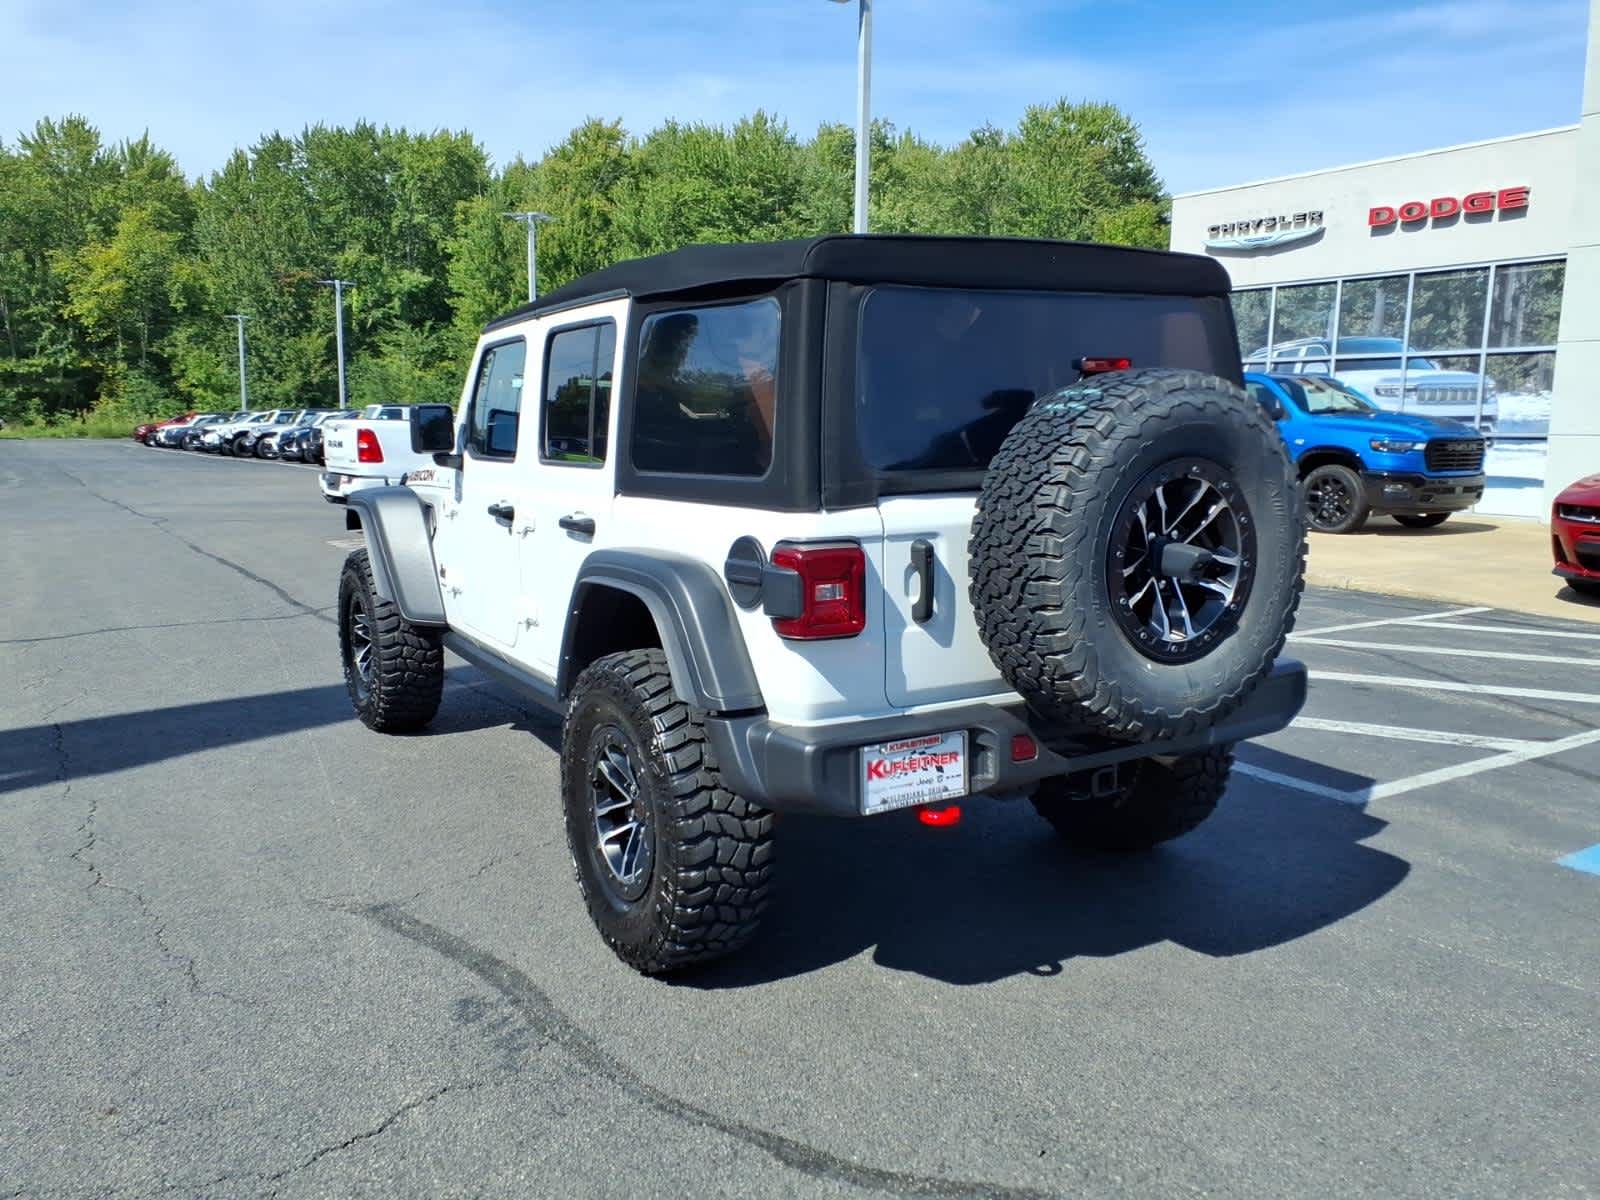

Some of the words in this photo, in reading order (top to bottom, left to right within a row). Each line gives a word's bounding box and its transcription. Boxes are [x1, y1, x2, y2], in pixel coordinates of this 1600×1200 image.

[1368, 186, 1530, 227] DODGE
[1207, 211, 1324, 230] CHRYSLER
[889, 736, 940, 751] KUFLEITNER
[867, 752, 959, 782] KUFLEITNER
